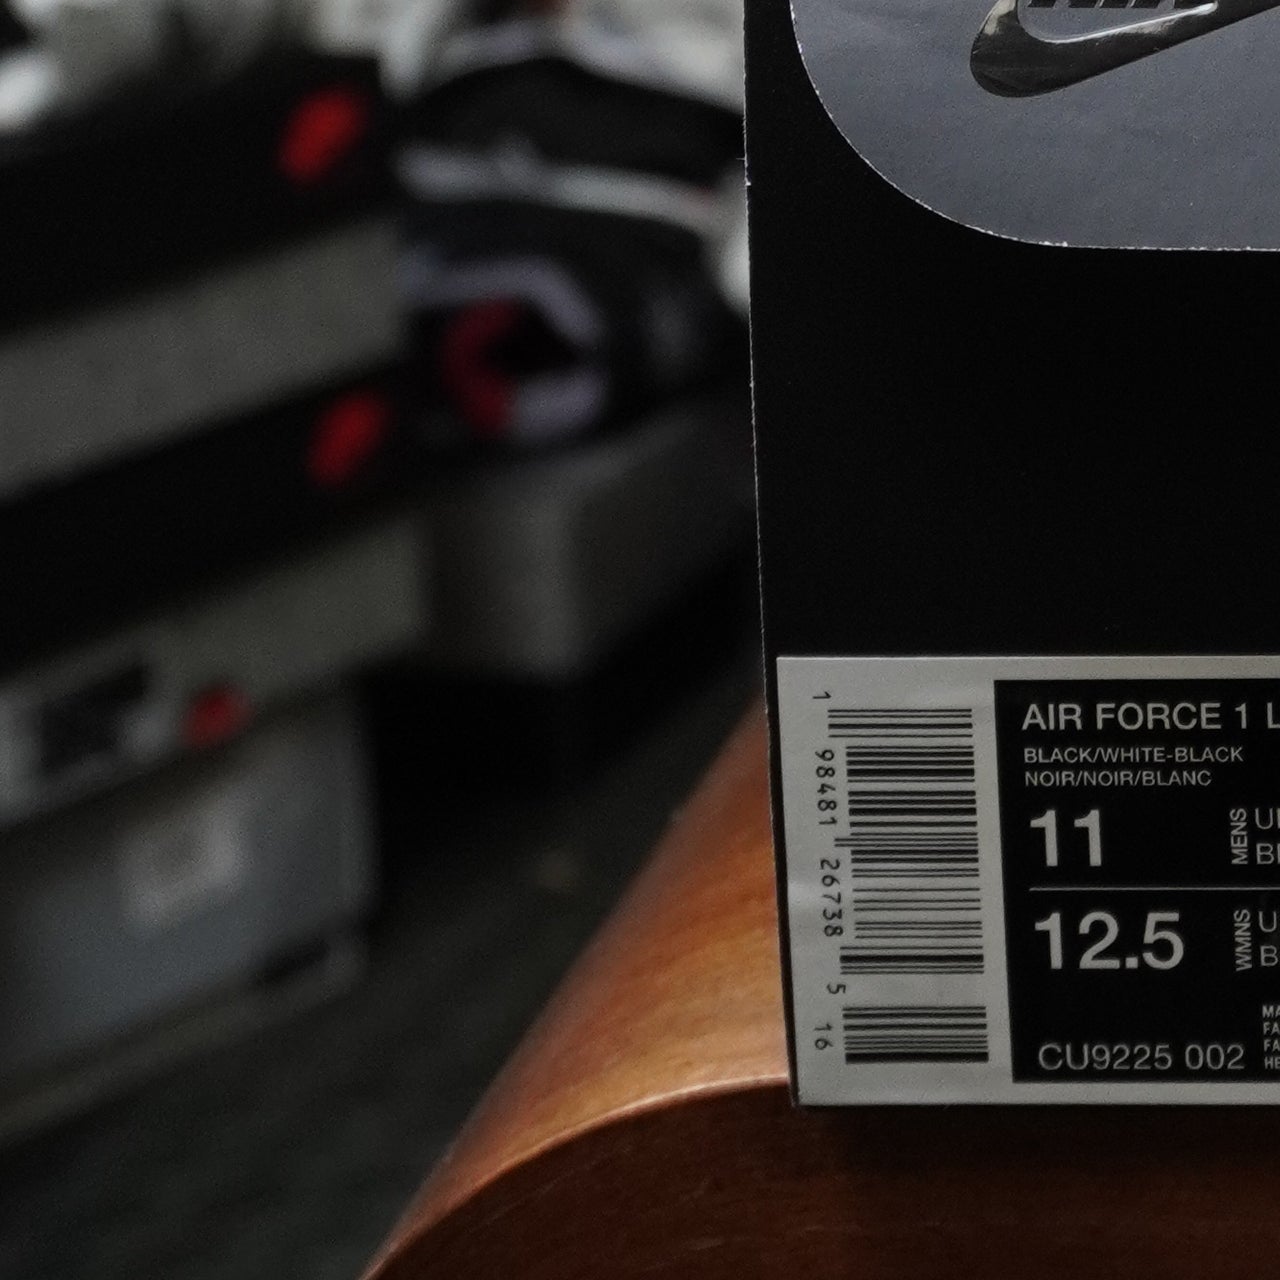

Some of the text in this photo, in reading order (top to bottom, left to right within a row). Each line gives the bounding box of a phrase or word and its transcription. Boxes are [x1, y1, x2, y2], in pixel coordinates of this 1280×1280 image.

[1021, 702, 1083, 731] AIR
[1095, 701, 1222, 731] FORCE
[1234, 702, 1247, 729] 1
[1023, 746, 1243, 764] BLACK/WHITE-BLACK
[1024, 769, 1212, 787] NOIR/NOIR/BLANC
[814, 748, 838, 826] 98481
[1029, 808, 1102, 867] 11
[1229, 807, 1248, 865] MENS
[819, 858, 845, 938] 26738
[1034, 910, 1185, 970] 12.5
[1233, 908, 1253, 972] WMNS
[1038, 1042, 1245, 1071] CU9225 002
